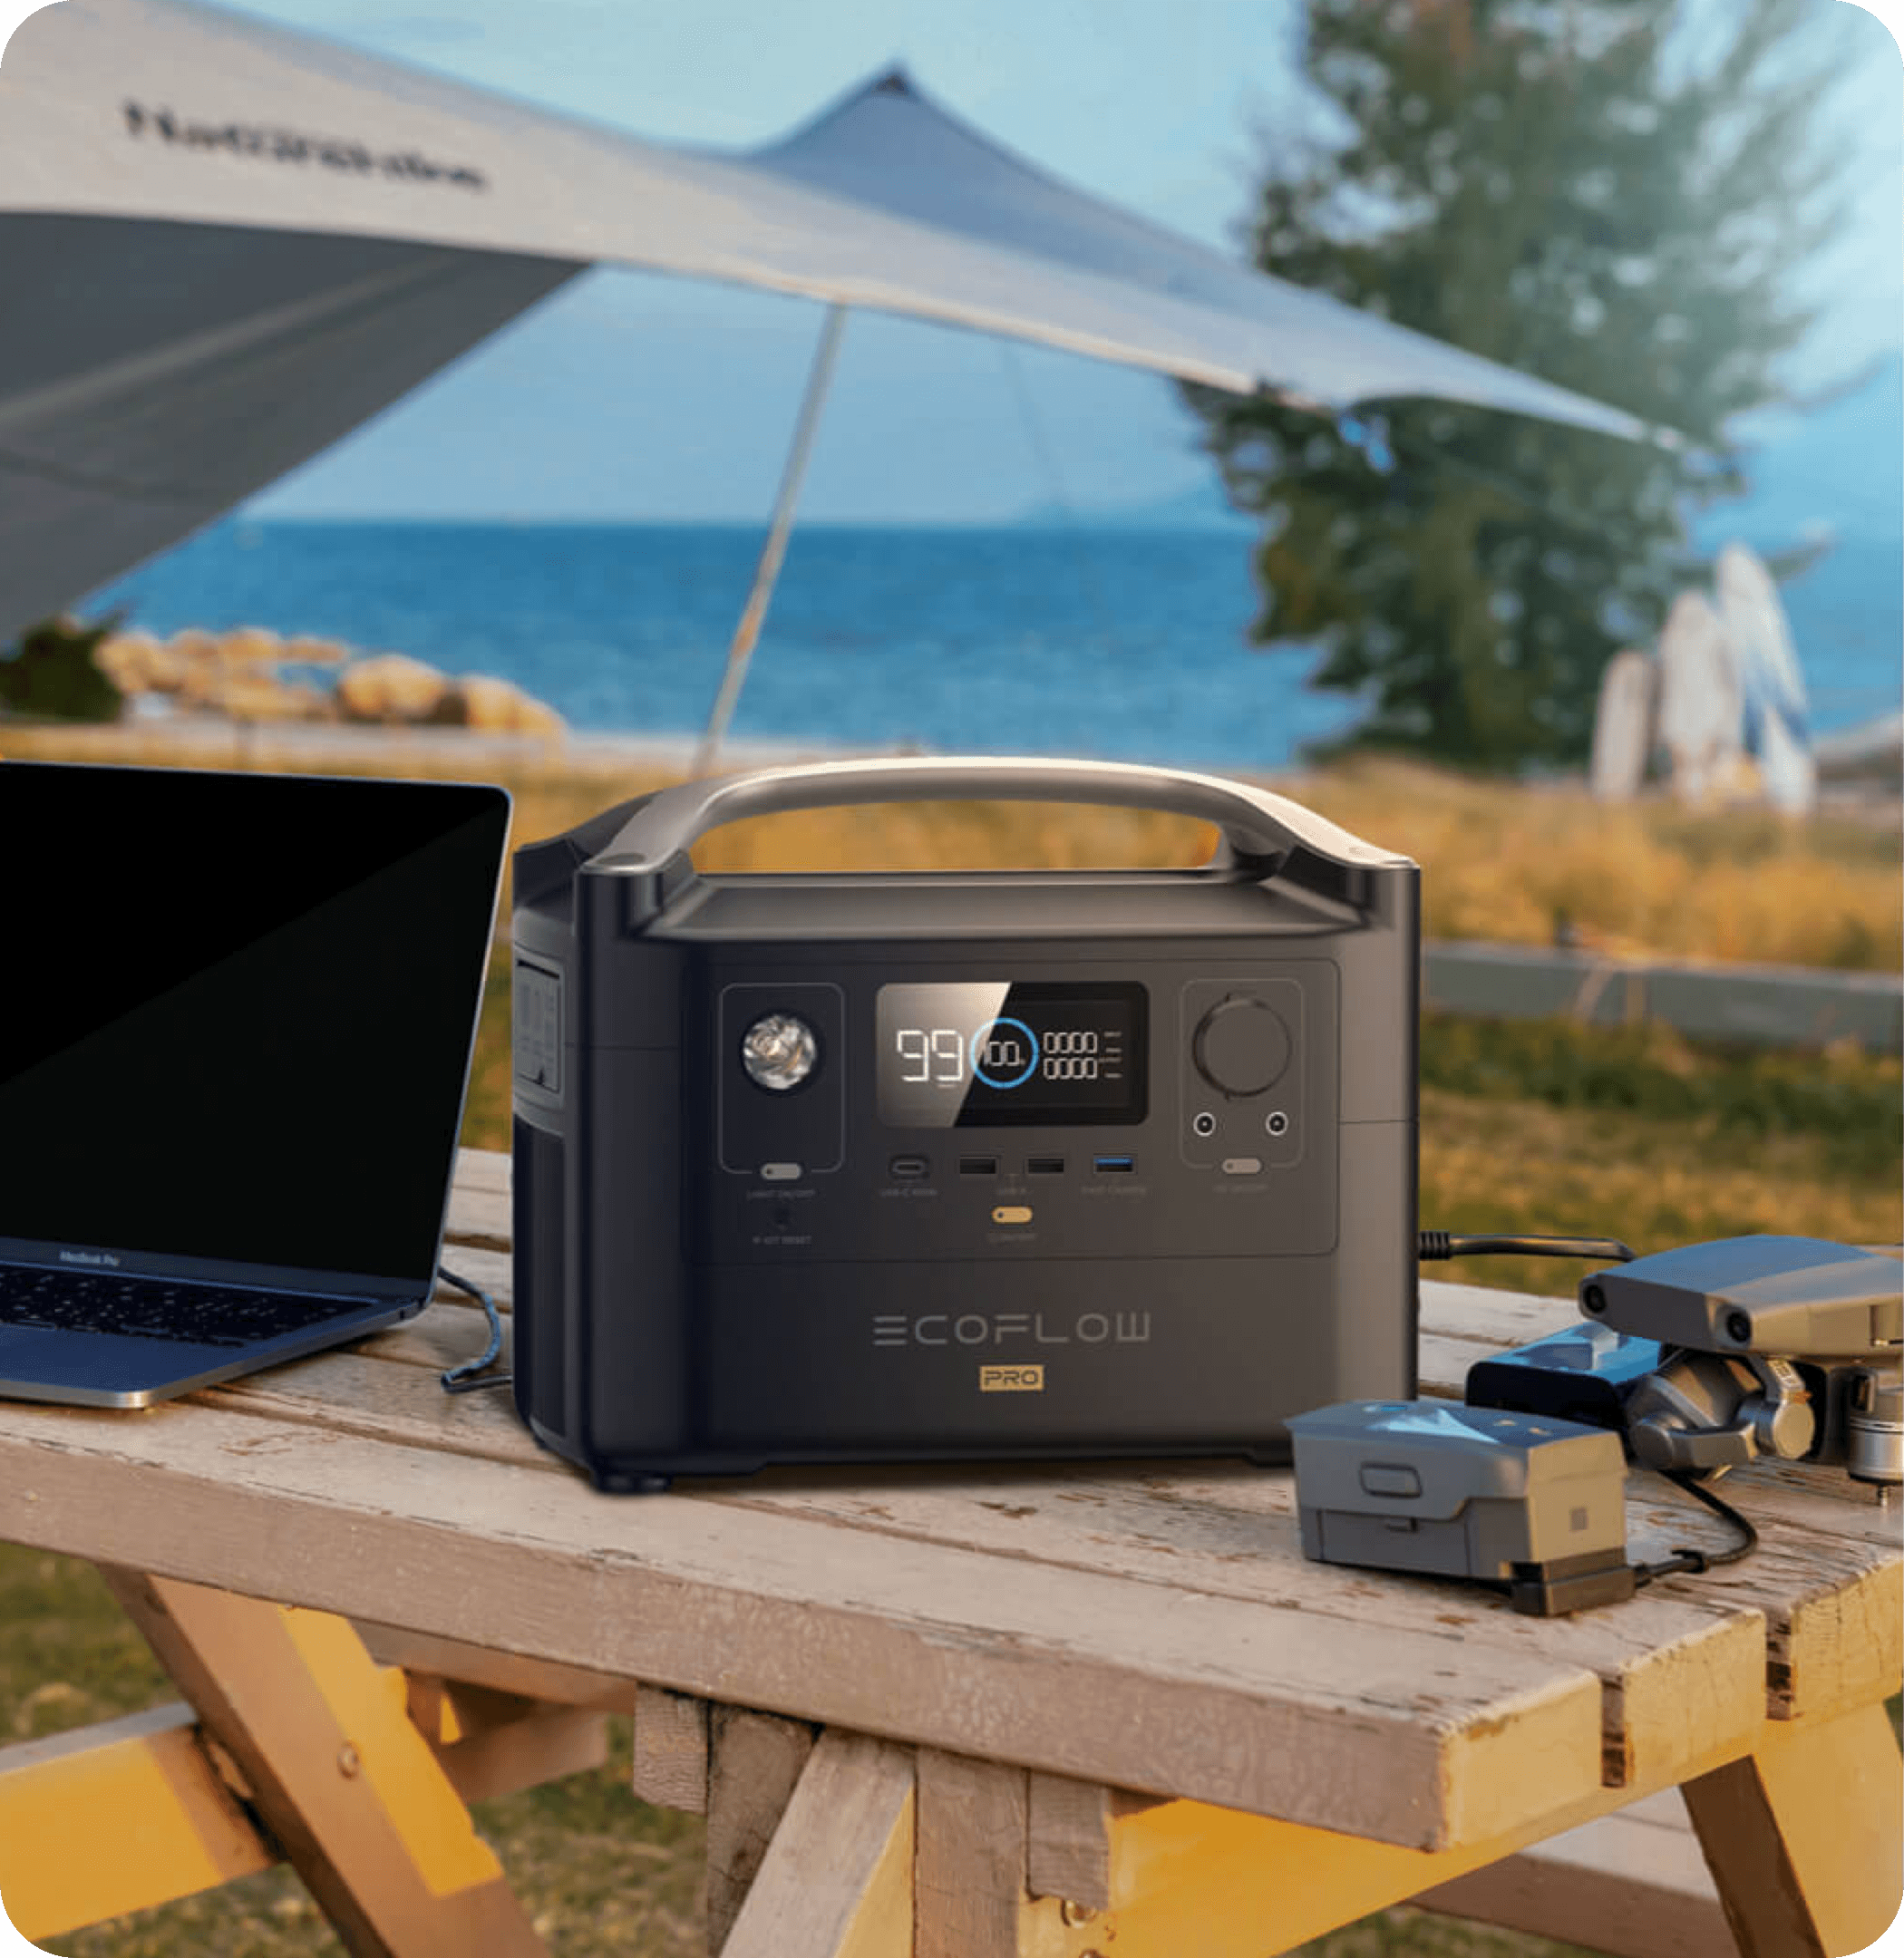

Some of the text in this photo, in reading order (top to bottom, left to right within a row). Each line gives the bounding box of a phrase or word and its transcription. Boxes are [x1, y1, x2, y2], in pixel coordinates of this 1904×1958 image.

[1044, 1032, 1097, 1053] 0000
[897, 1030, 963, 1081] 99
[1044, 1057, 1097, 1080] 0000
[873, 1313, 1150, 1345] ECOFLOW
[984, 1370, 1039, 1386] PRO
